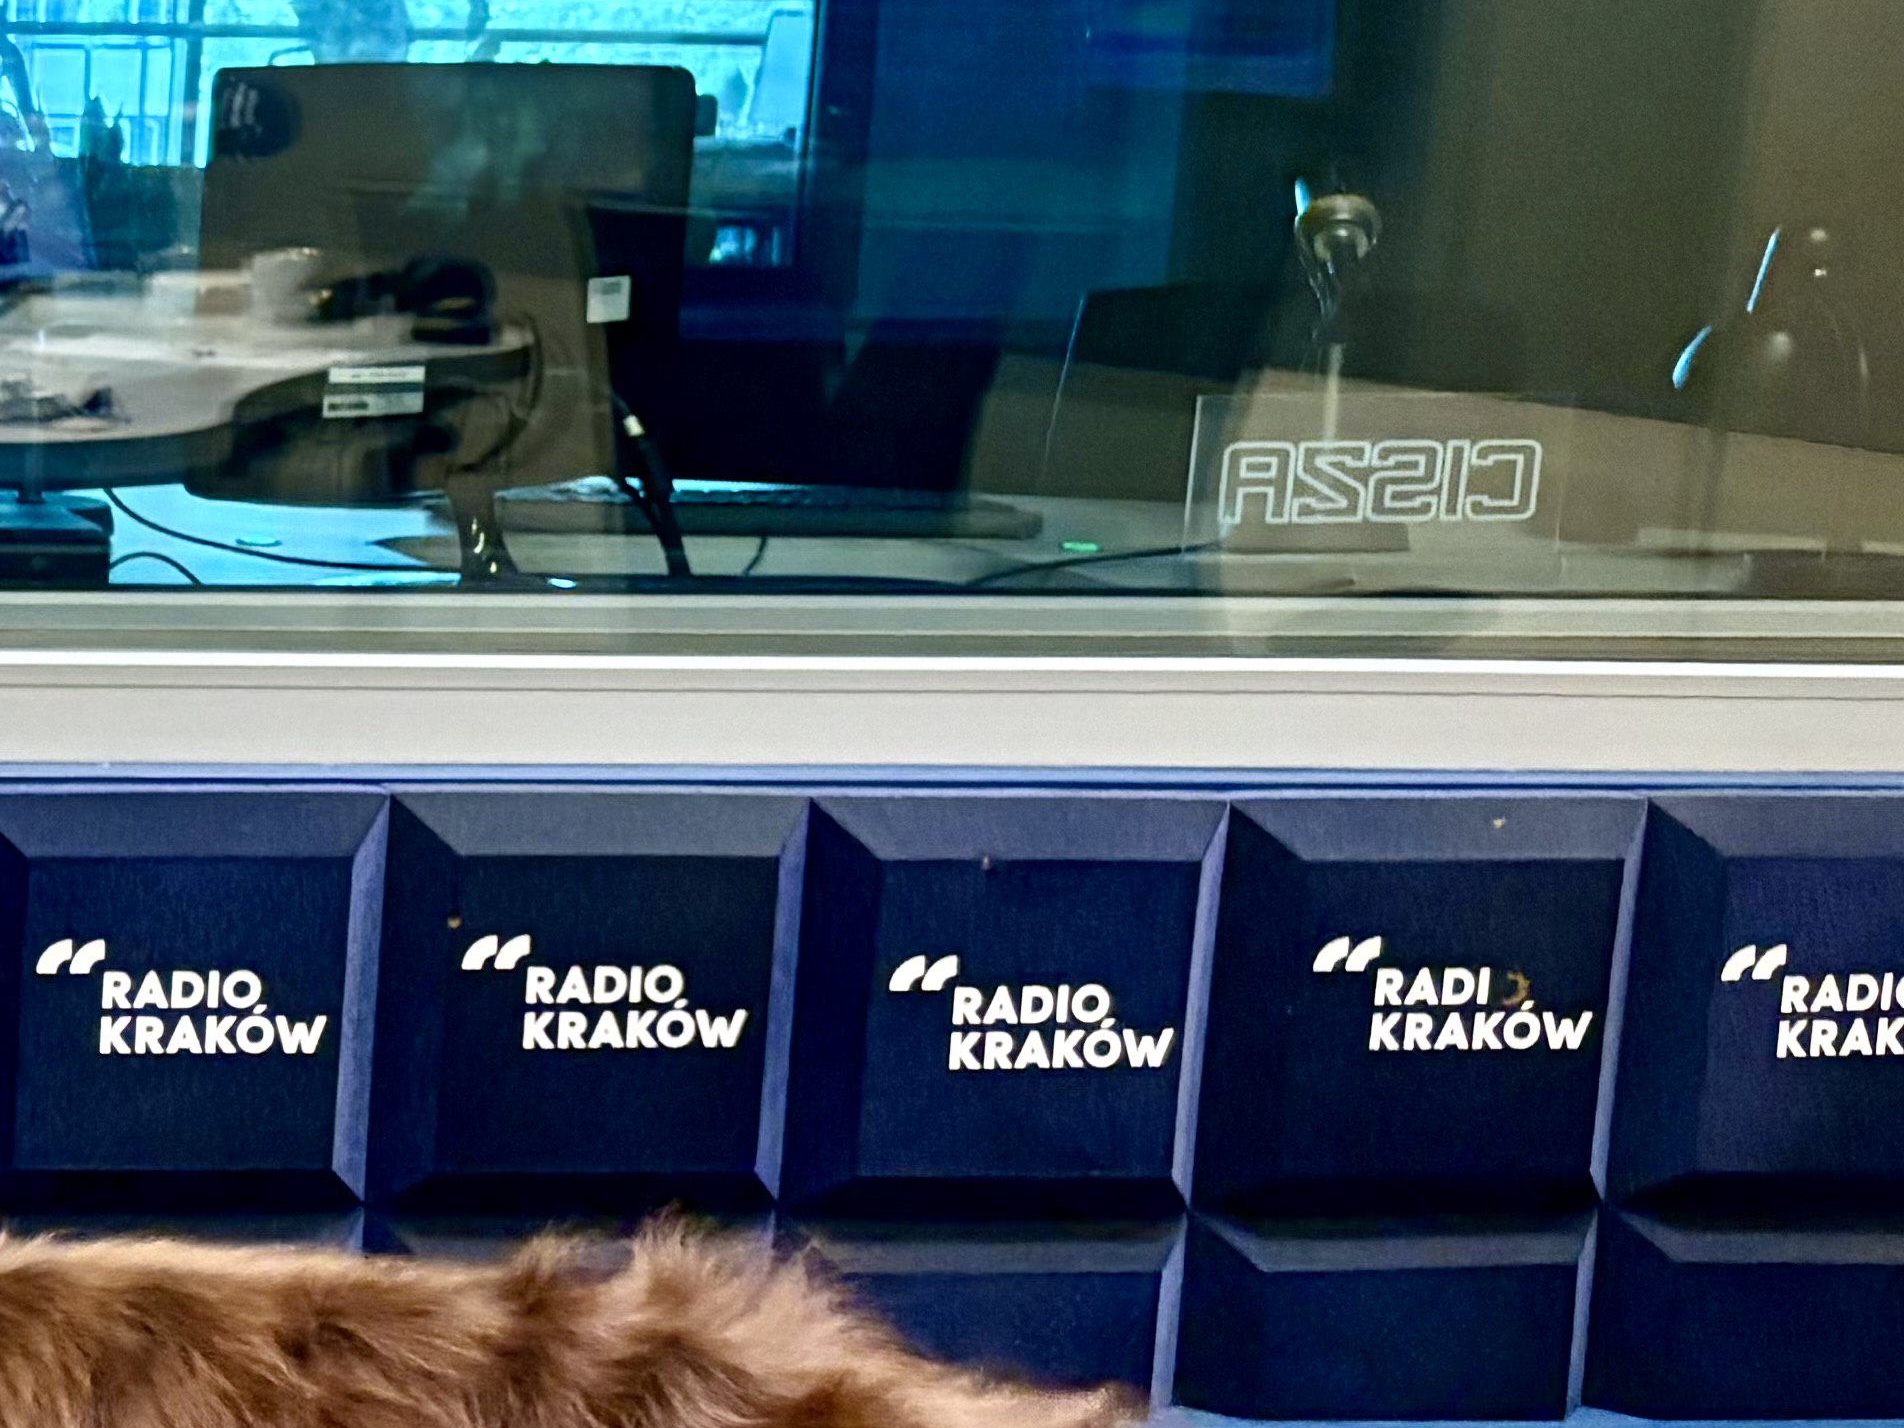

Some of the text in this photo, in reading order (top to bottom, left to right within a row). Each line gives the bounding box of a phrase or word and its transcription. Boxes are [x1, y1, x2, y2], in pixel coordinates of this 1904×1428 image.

[101, 970, 262, 1010] RADIO
[525, 965, 684, 1005] RADIO
[951, 984, 1111, 1026] RADIO
[1374, 966, 1530, 1007] RADI
[1780, 972, 1904, 1014] RADI
[99, 1004, 328, 1055] KRAKÓW
[522, 999, 747, 1050] KRAKÓW
[948, 1018, 1175, 1071] KRAKÓW
[1368, 1000, 1593, 1051] KRAKÓW
[1776, 1017, 1904, 1059] KRAK
